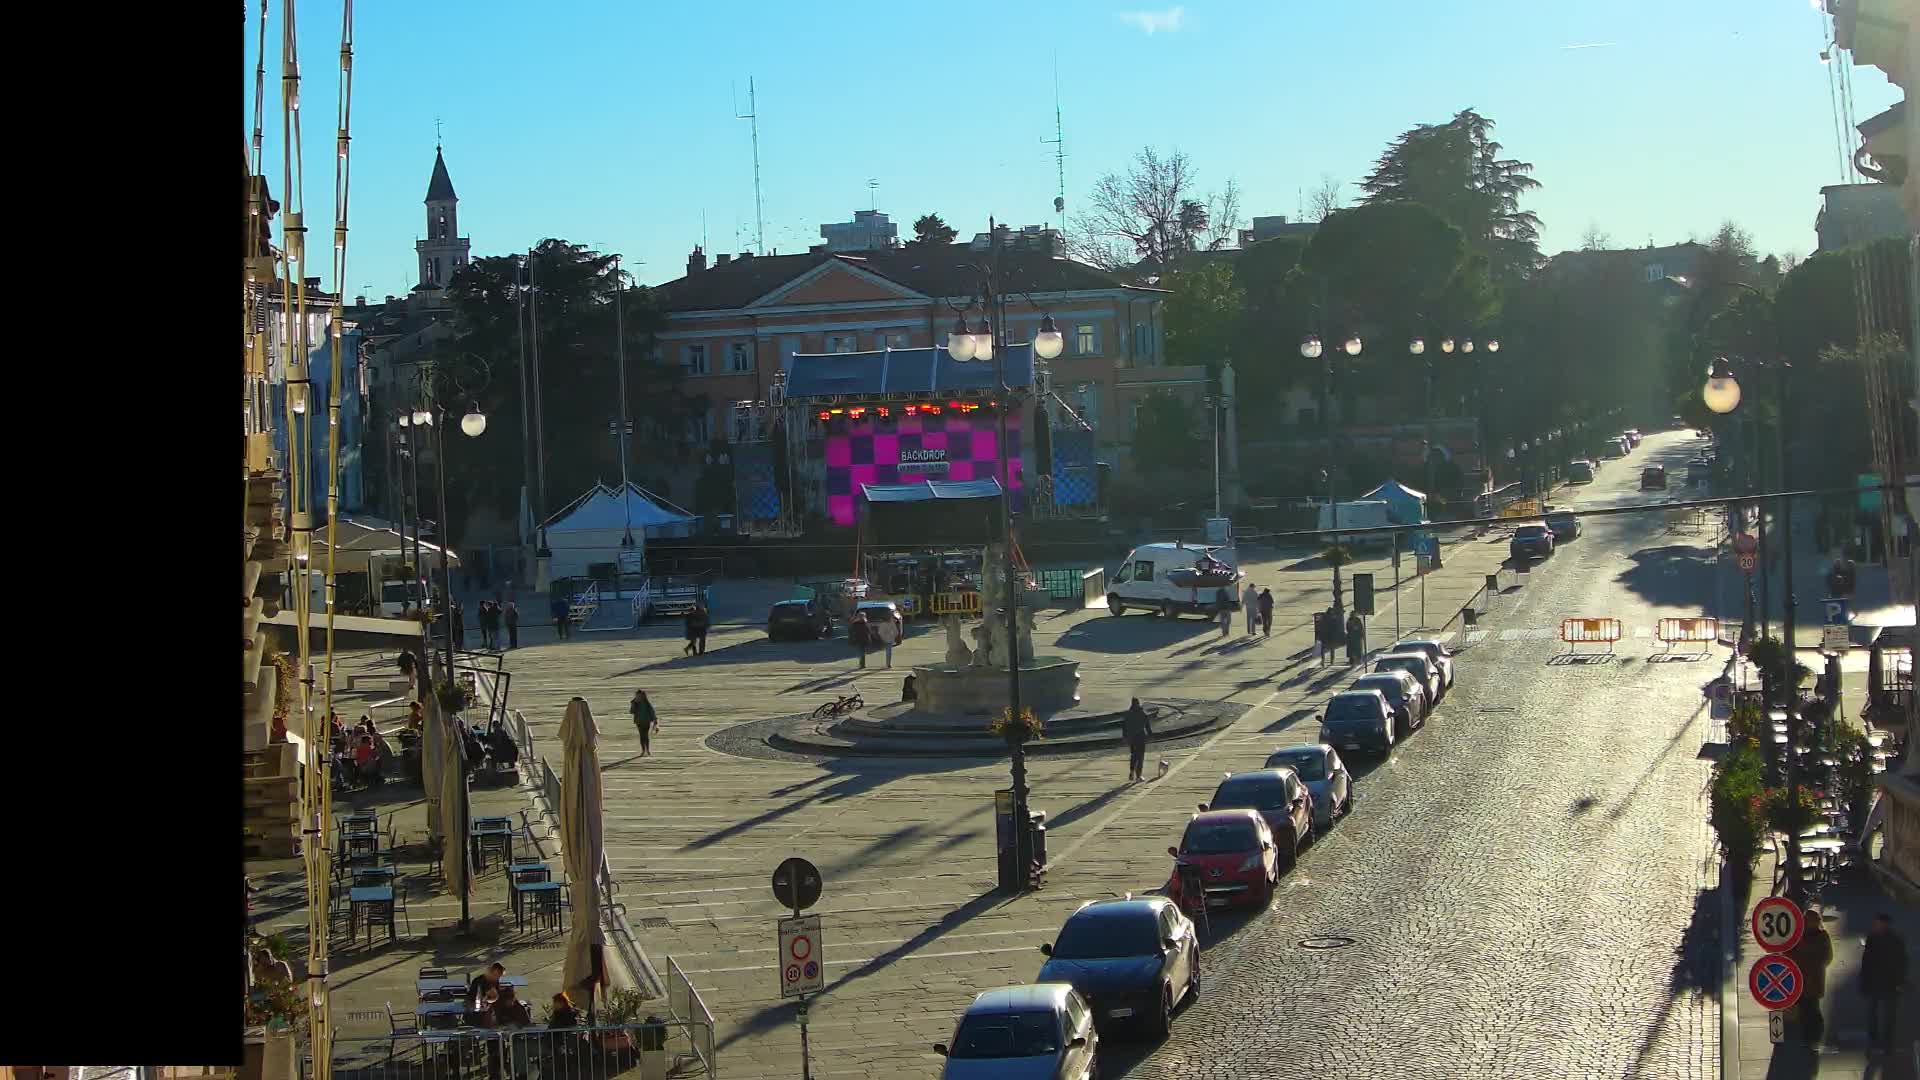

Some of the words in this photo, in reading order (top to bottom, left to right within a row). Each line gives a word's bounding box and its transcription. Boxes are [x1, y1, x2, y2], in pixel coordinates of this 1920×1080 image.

[901, 449, 946, 461] BACKDROP
[1742, 558, 1752, 567] 20
[1761, 912, 1791, 938] 30
